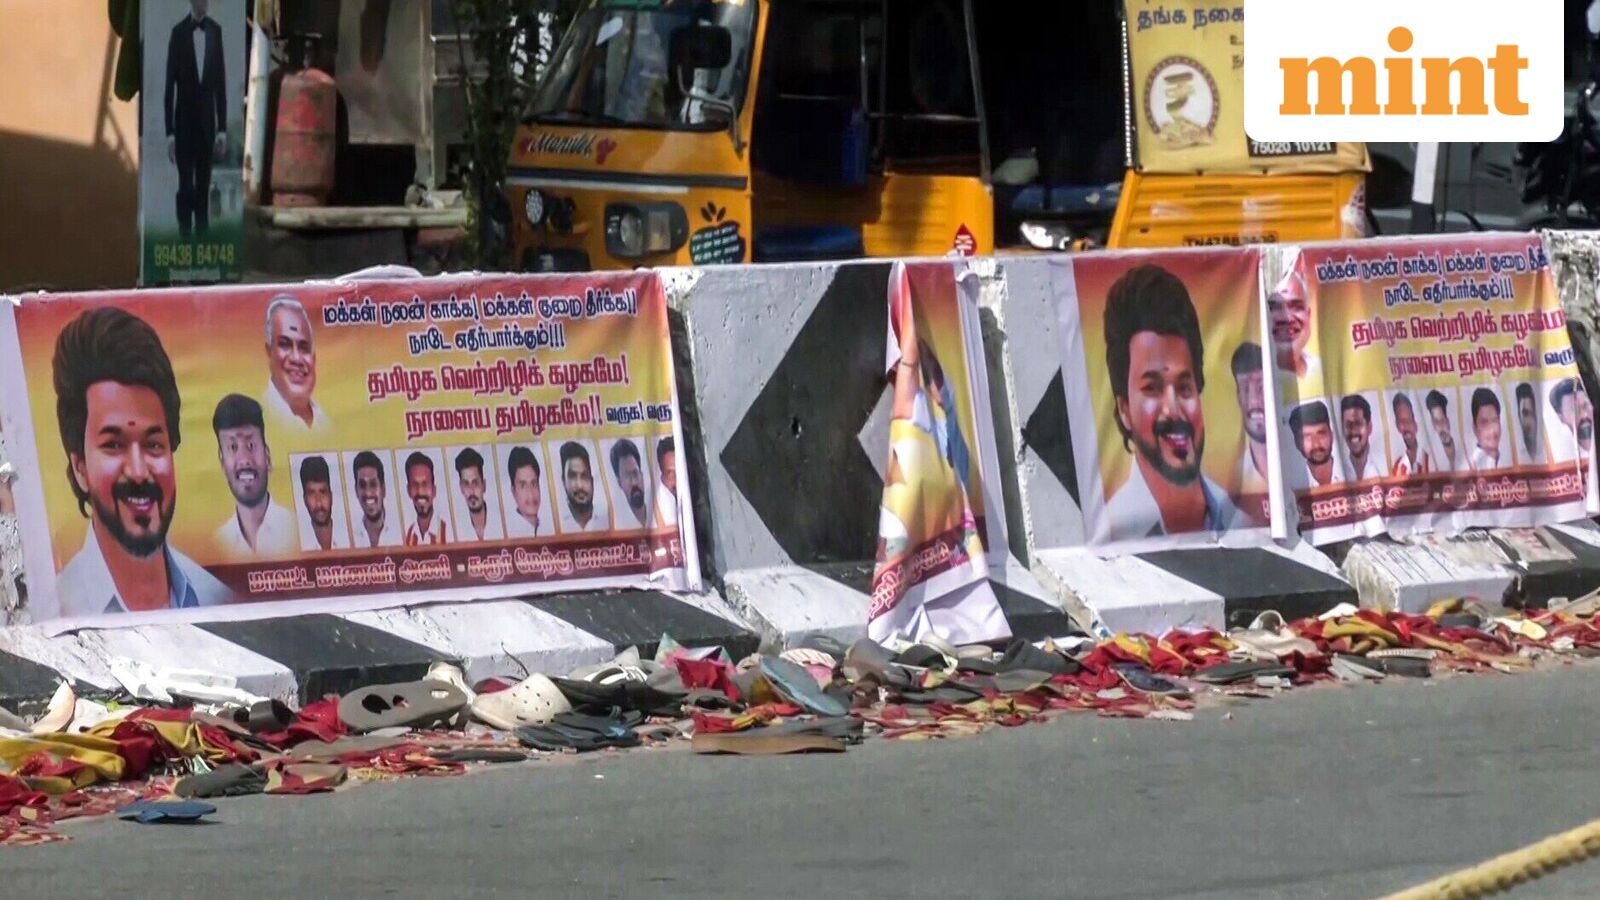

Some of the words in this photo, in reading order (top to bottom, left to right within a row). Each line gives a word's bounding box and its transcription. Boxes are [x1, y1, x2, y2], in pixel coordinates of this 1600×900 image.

[1137, 6, 1186, 32] தங்க
[1317, 257, 1358, 280] மக்கள்
[1361, 255, 1398, 279] நலன்
[1403, 253, 1442, 275] காக்க!
[1445, 250, 1486, 272] மக்கள்
[324, 299, 376, 324] மக்கள்
[381, 298, 427, 324] நலன்
[431, 295, 478, 321] காக்க!
[483, 292, 534, 318] மக்கள்
[539, 297, 582, 319] குறை
[586, 288, 637, 316] தீர்க்க!!
[1384, 281, 1420, 306] நாடே
[408, 325, 450, 354] நாடே
[455, 322, 566, 352] எதிர்பார்க்கும்!!!
[1352, 316, 1408, 350] தமிழக
[368, 364, 437, 401] தமிழக
[548, 354, 629, 393] கழகமே!
[405, 405, 491, 440] நாளைய
[495, 395, 603, 435] தமிழகமே!!
[606, 401, 645, 424] வருக!
[248, 566, 314, 592] மாவட்ட
[316, 556, 396, 588] மாணவர்
[400, 554, 451, 583] அணி
